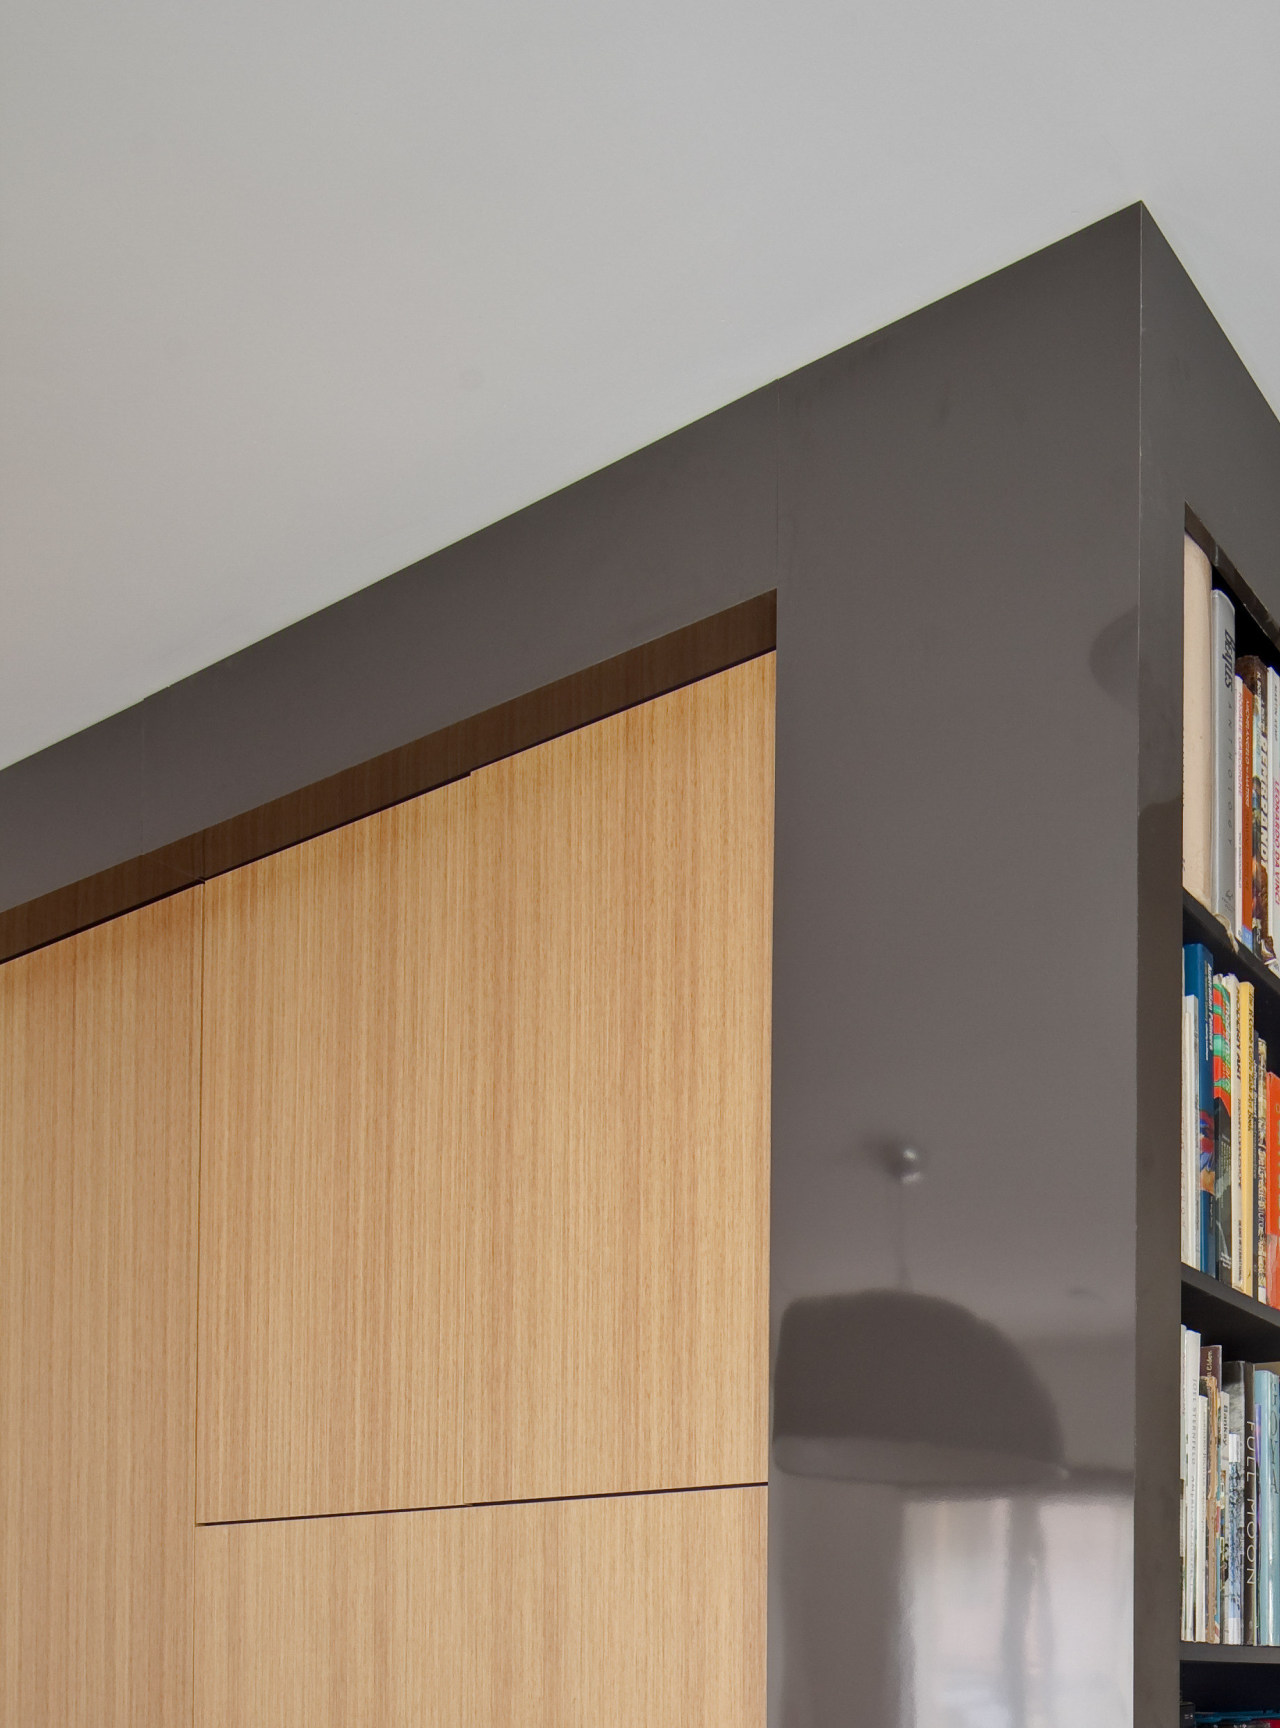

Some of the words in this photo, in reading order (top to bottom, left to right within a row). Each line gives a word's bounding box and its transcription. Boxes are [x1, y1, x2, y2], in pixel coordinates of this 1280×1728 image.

[1221, 627, 1234, 694] BEATLES
[1221, 1403, 1229, 1447] Banksy
[1245, 1419, 1255, 1483] FULL
[1245, 1498, 1255, 1586] MOON
